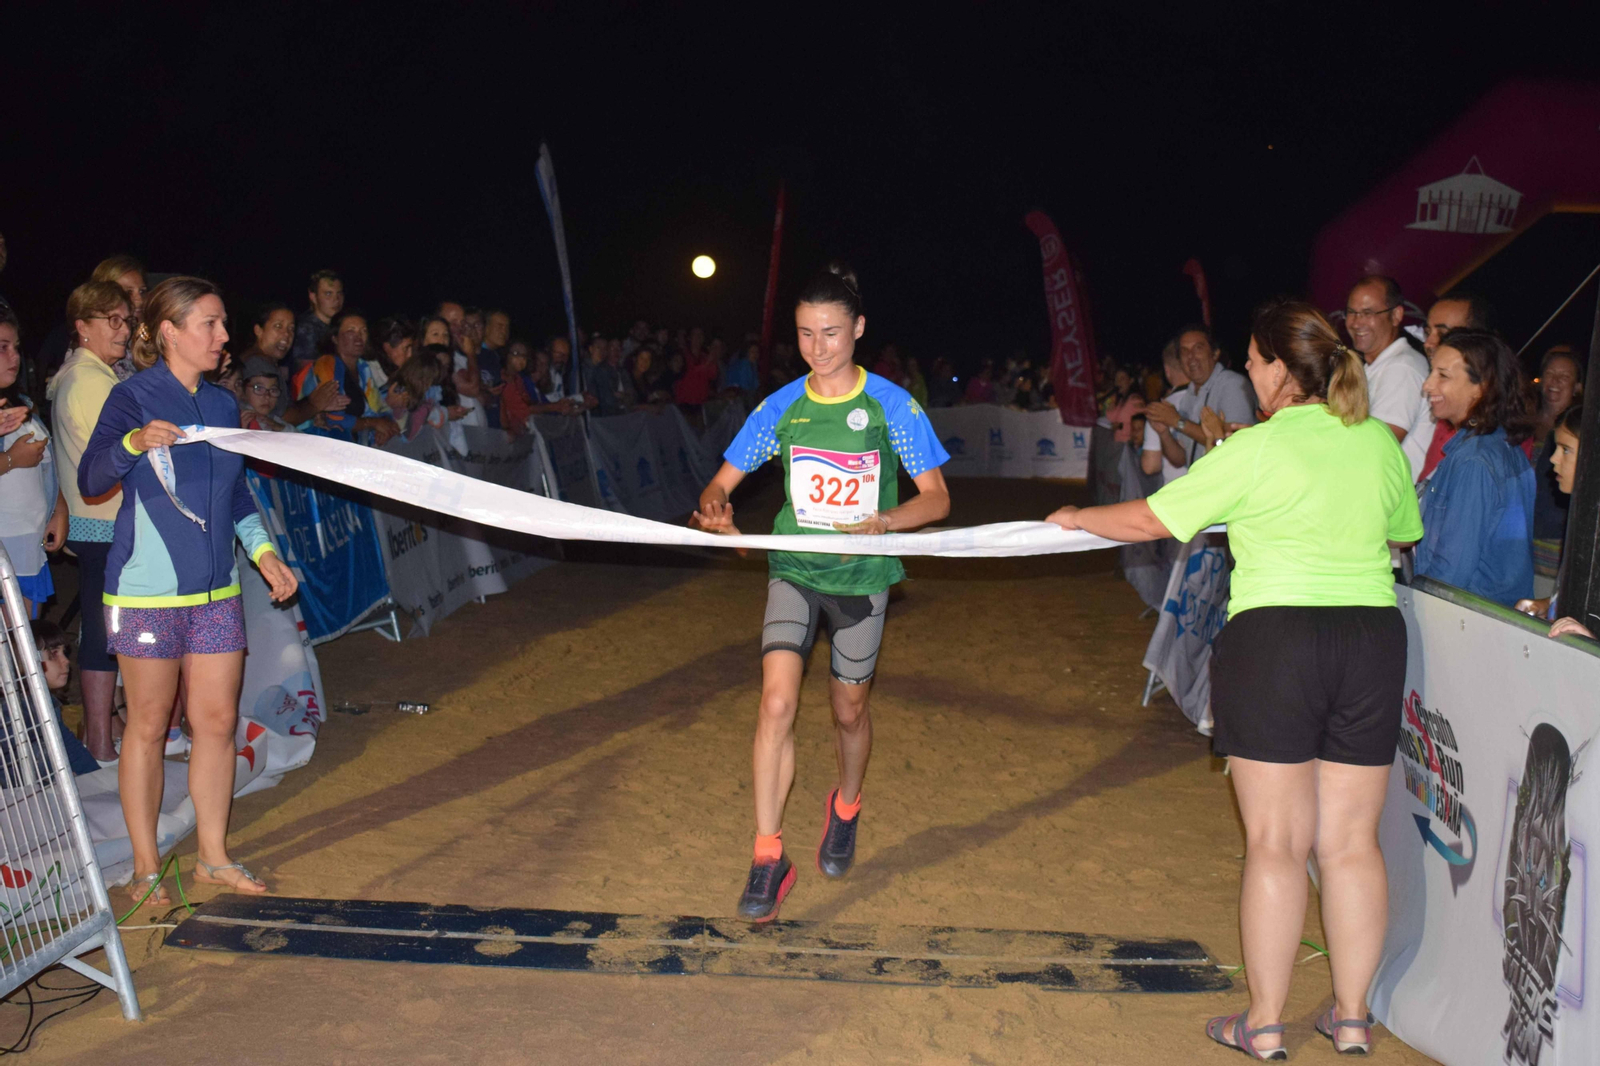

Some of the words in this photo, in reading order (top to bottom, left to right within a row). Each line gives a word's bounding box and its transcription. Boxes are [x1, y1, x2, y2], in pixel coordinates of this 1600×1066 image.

[809, 474, 860, 506] 322
[387, 520, 429, 561] Iberitos
[1414, 698, 1459, 753] Circuito
